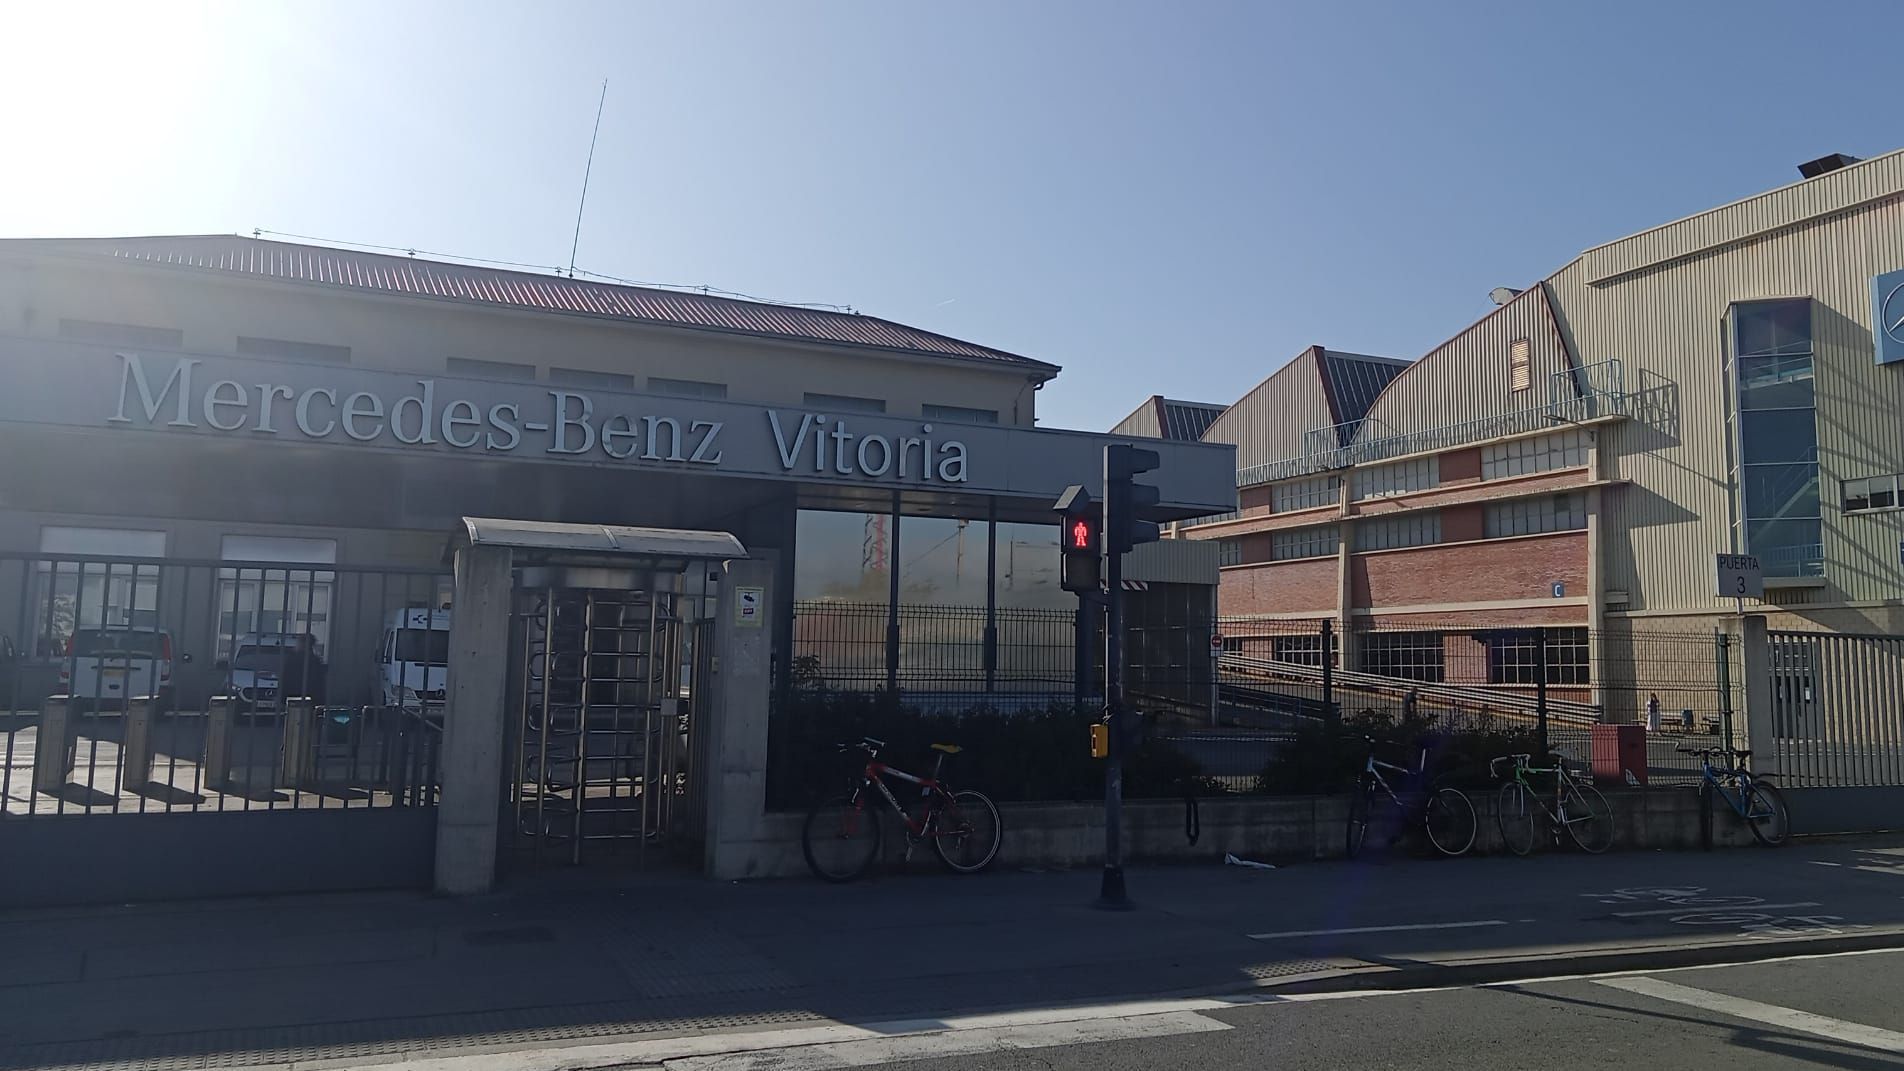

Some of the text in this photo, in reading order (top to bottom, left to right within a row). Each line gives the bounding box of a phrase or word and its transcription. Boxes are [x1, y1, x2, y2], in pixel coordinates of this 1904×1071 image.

[109, 352, 968, 483] Mercedes-Benz Vitoria
[1719, 556, 1760, 570] PUERTA
[1554, 584, 1561, 597] C
[1737, 575, 1746, 594] 3
